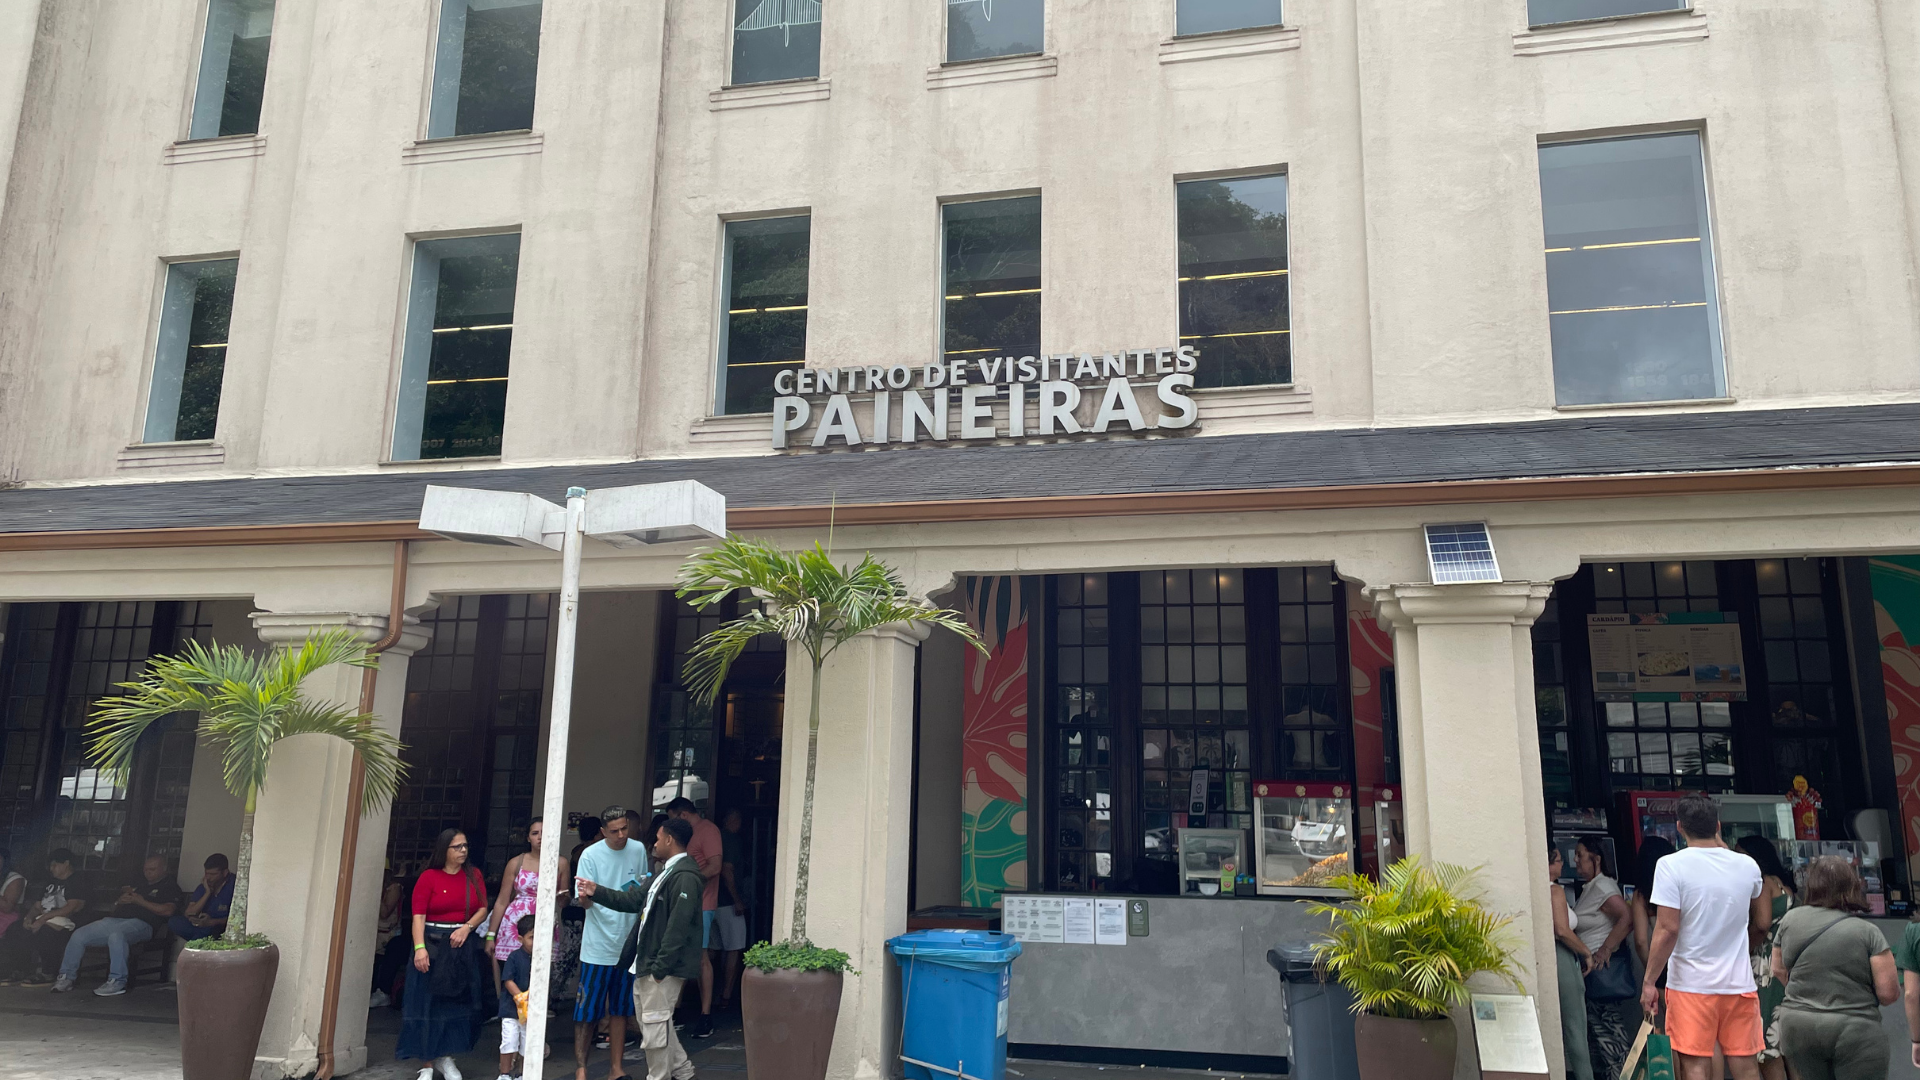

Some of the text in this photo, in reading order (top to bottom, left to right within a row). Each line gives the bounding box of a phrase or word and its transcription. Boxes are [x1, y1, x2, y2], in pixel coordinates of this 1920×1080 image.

[774, 345, 1199, 395] CENTRO DE VISITANTES
[772, 373, 1200, 450] PAINEIRAS
[422, 438, 445, 449] 007
